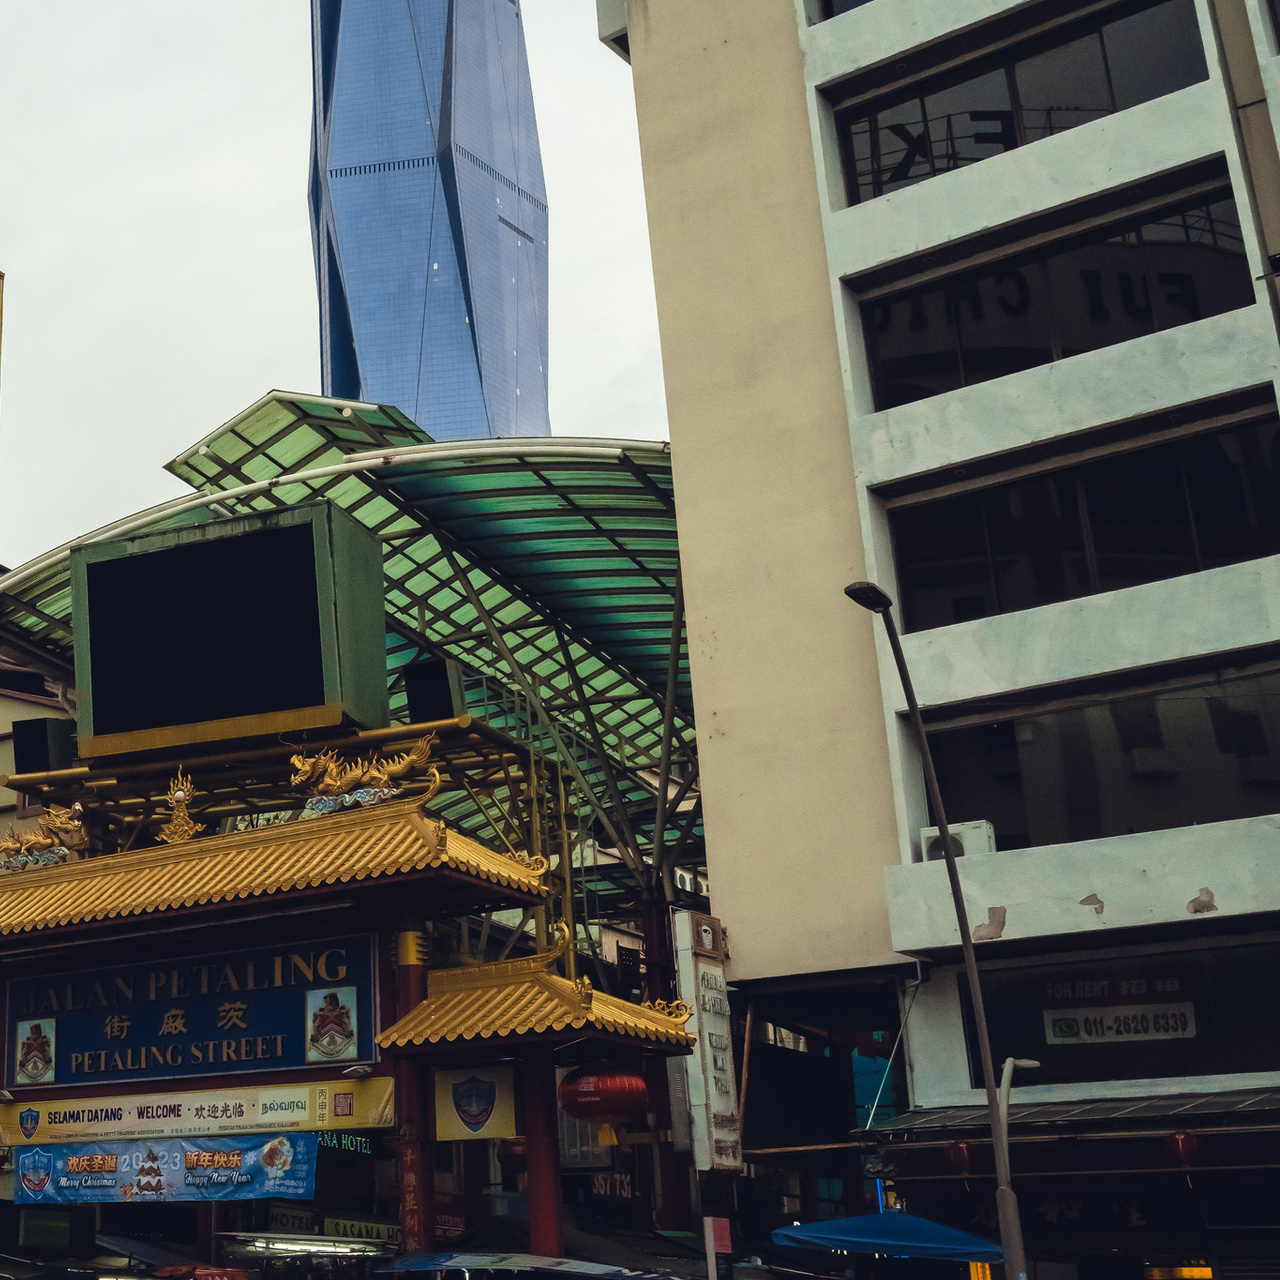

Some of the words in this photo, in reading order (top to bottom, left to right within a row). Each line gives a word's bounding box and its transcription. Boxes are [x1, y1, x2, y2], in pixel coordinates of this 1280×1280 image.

[23, 974, 135, 1015] JALAN
[148, 948, 348, 1003] PETALING
[1046, 981, 1073, 1000] FOR
[1075, 979, 1110, 999] RENT
[1083, 1013, 1150, 1037] 011-2620
[1152, 1012, 1188, 1033] 6339
[70, 1043, 184, 1074] PETALING
[190, 1034, 288, 1066] STREET
[48, 1109, 86, 1125] SELAMAT
[87, 1107, 123, 1122] DATANG
[136, 1104, 182, 1120] WELCOME
[194, 1102, 245, 1120] 欢迎光临
[341, 1134, 371, 1155] HOTEL
[66, 1153, 118, 1174] 欢庆圣诞
[184, 1149, 243, 1170] 新年快乐
[57, 1175, 81, 1190] Merry
[185, 1172, 208, 1188] Happy
[210, 1172, 228, 1183] New
[230, 1172, 253, 1185] Year
[271, 1211, 310, 1230] HOTEL
[335, 1221, 382, 1240] SASANA
